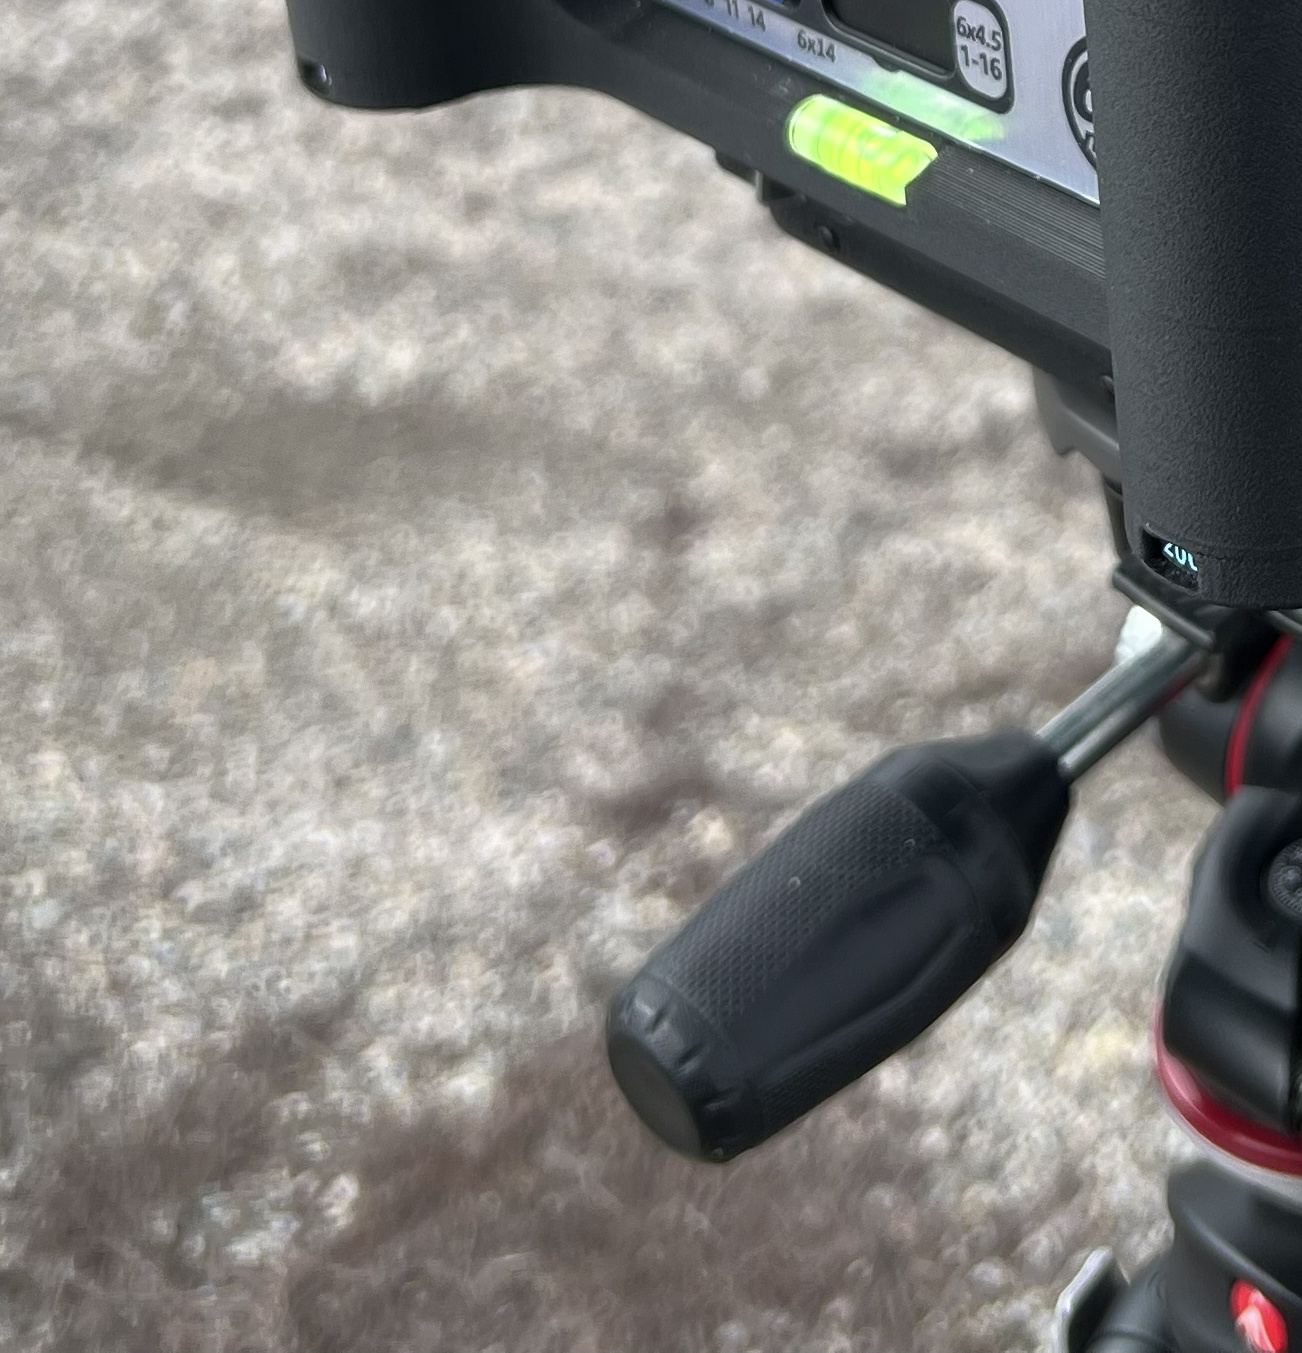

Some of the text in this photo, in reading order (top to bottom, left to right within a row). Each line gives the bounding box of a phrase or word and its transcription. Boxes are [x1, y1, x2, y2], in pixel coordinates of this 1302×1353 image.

[747, 5, 767, 33] 14
[956, 15, 1002, 51] 6x4.5
[796, 28, 837, 63] 6x14
[960, 44, 1003, 81] 1-16
